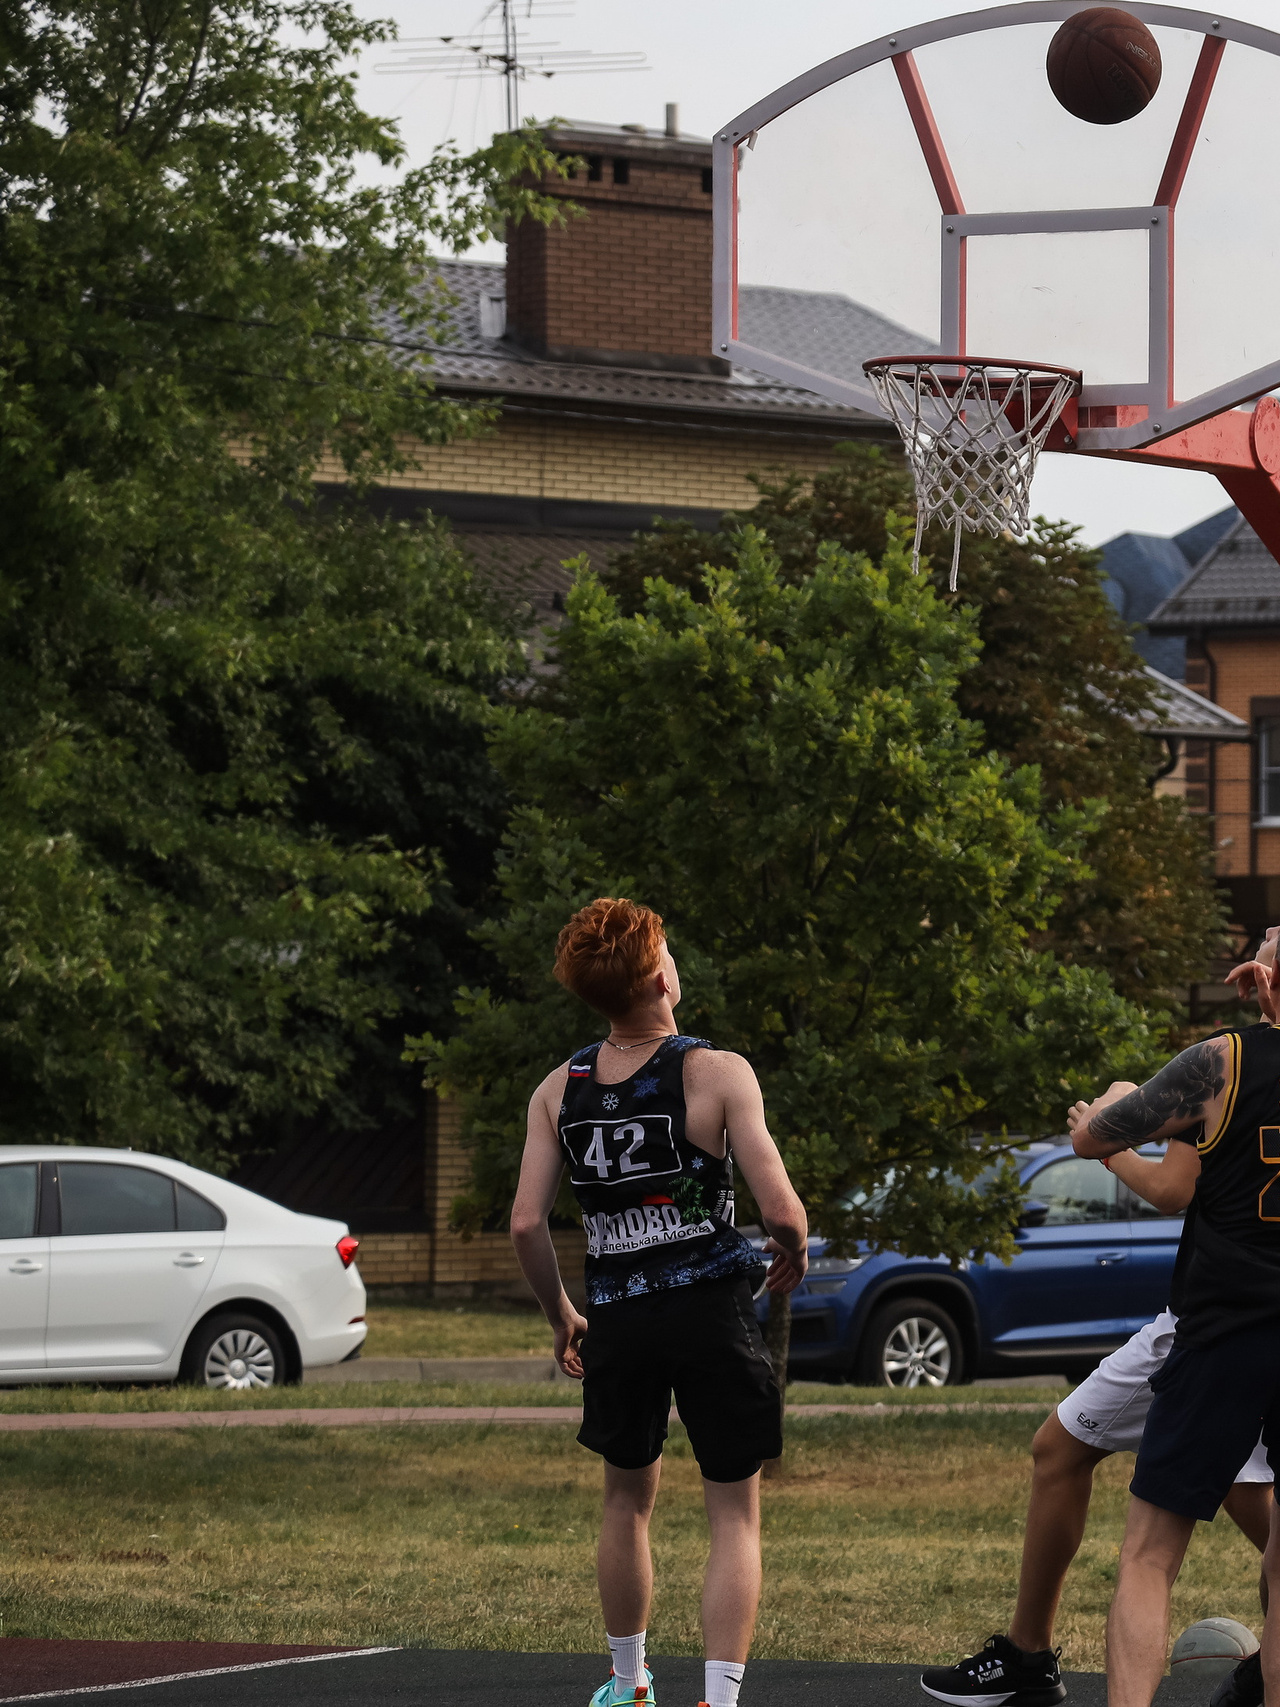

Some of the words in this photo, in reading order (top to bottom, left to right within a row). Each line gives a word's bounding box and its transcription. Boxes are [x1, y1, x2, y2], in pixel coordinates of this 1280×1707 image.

[583, 1122, 651, 1178] 42
[600, 1235, 660, 1252] аленькая
[1076, 1412, 1100, 1431] EA7
